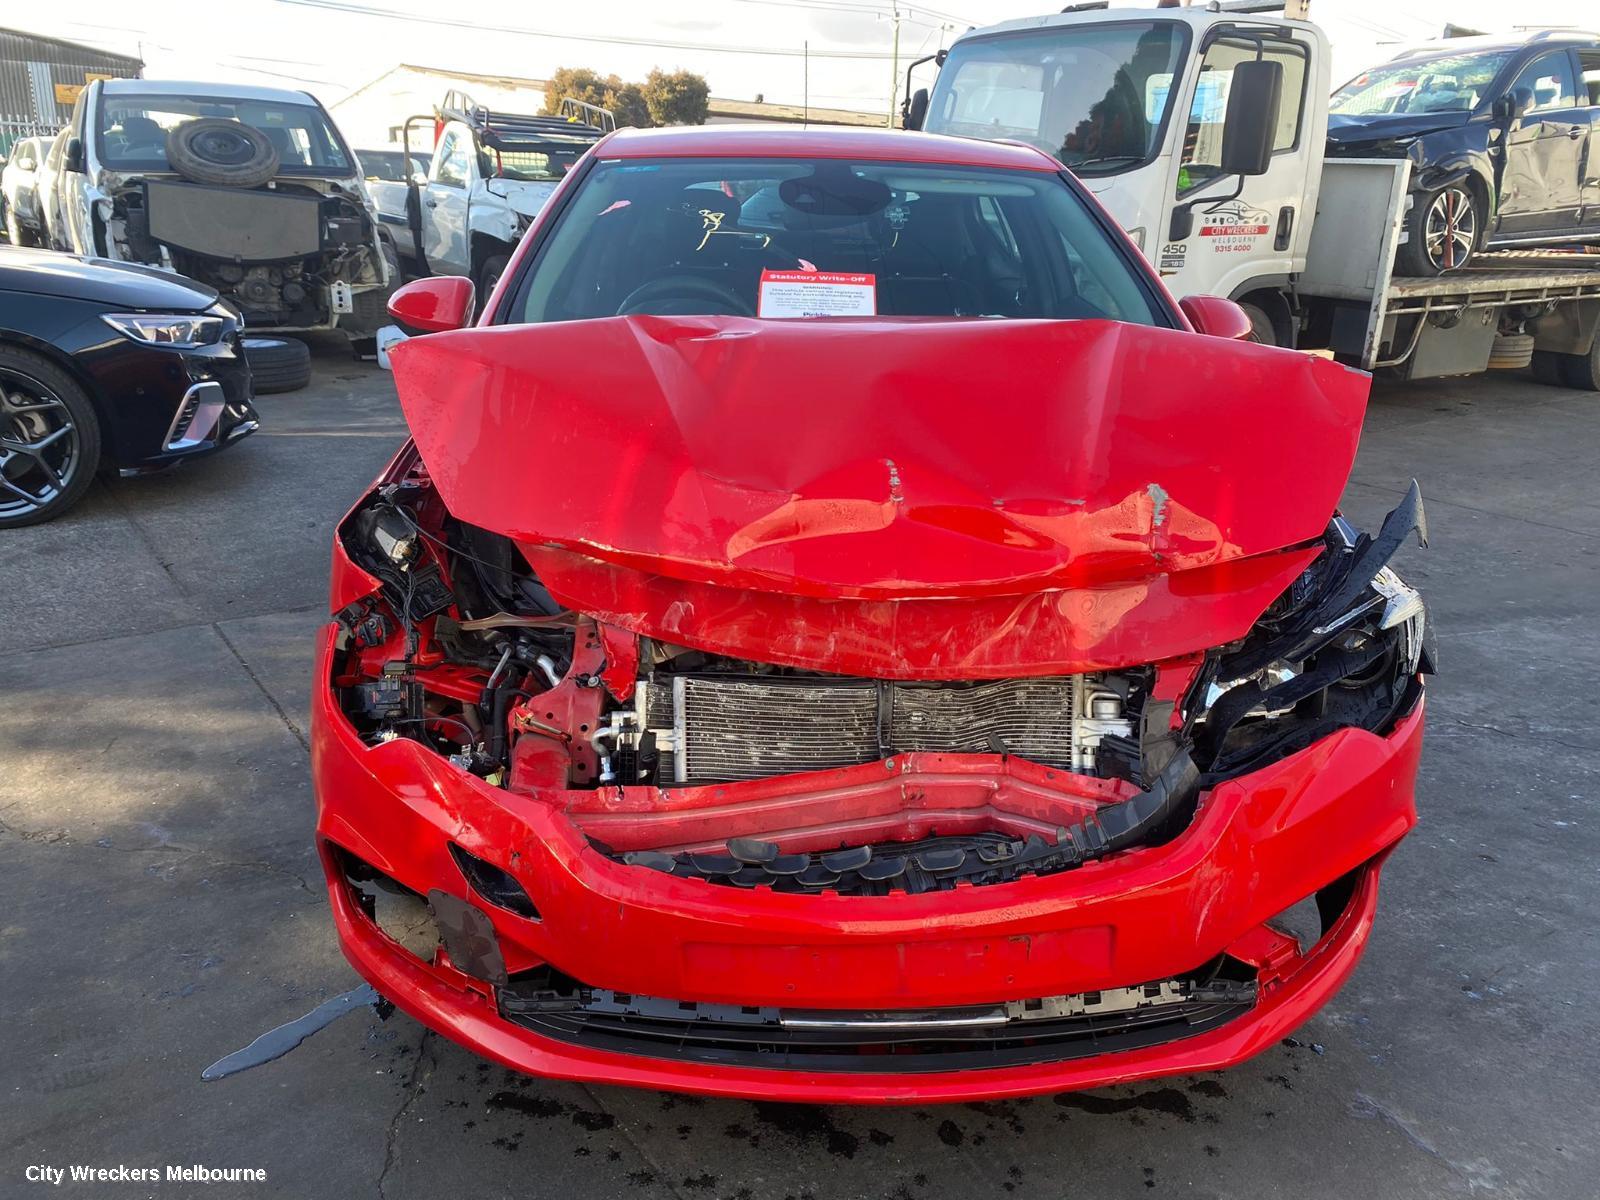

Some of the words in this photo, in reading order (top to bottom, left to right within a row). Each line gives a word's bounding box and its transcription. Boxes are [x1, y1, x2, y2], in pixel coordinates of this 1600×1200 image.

[1211, 226, 1225, 235] CITY
[1162, 244, 1187, 254] 450
[769, 273, 817, 281] Statutory
